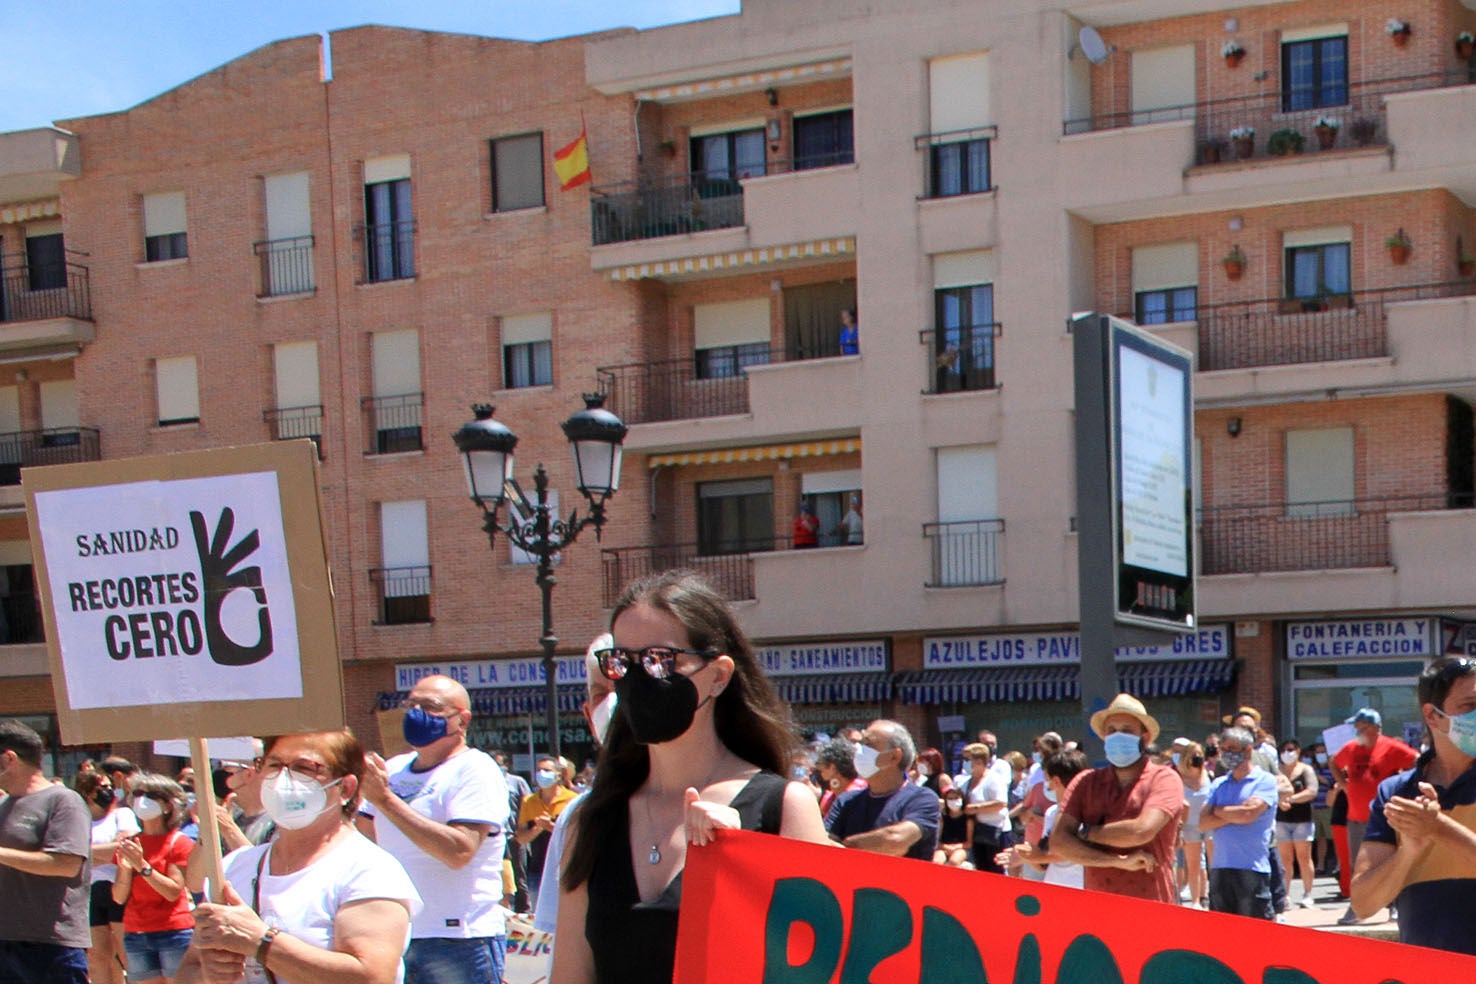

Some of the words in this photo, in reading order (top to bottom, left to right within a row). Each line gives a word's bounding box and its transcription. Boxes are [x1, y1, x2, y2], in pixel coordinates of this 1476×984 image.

[77, 527, 179, 557] SANIDAD
[68, 572, 199, 612] RECORTES
[105, 609, 203, 661] CERO
[1291, 622, 1405, 640] FONTANERIA
[1416, 621, 1425, 635] Y
[791, 646, 882, 669] SANEAMIENTOS
[929, 638, 1025, 663] AZULEJOS
[1173, 630, 1222, 654] GRES
[1295, 639, 1423, 656] CALEFACCION
[451, 664, 469, 683] DE
[478, 662, 499, 683] LA
